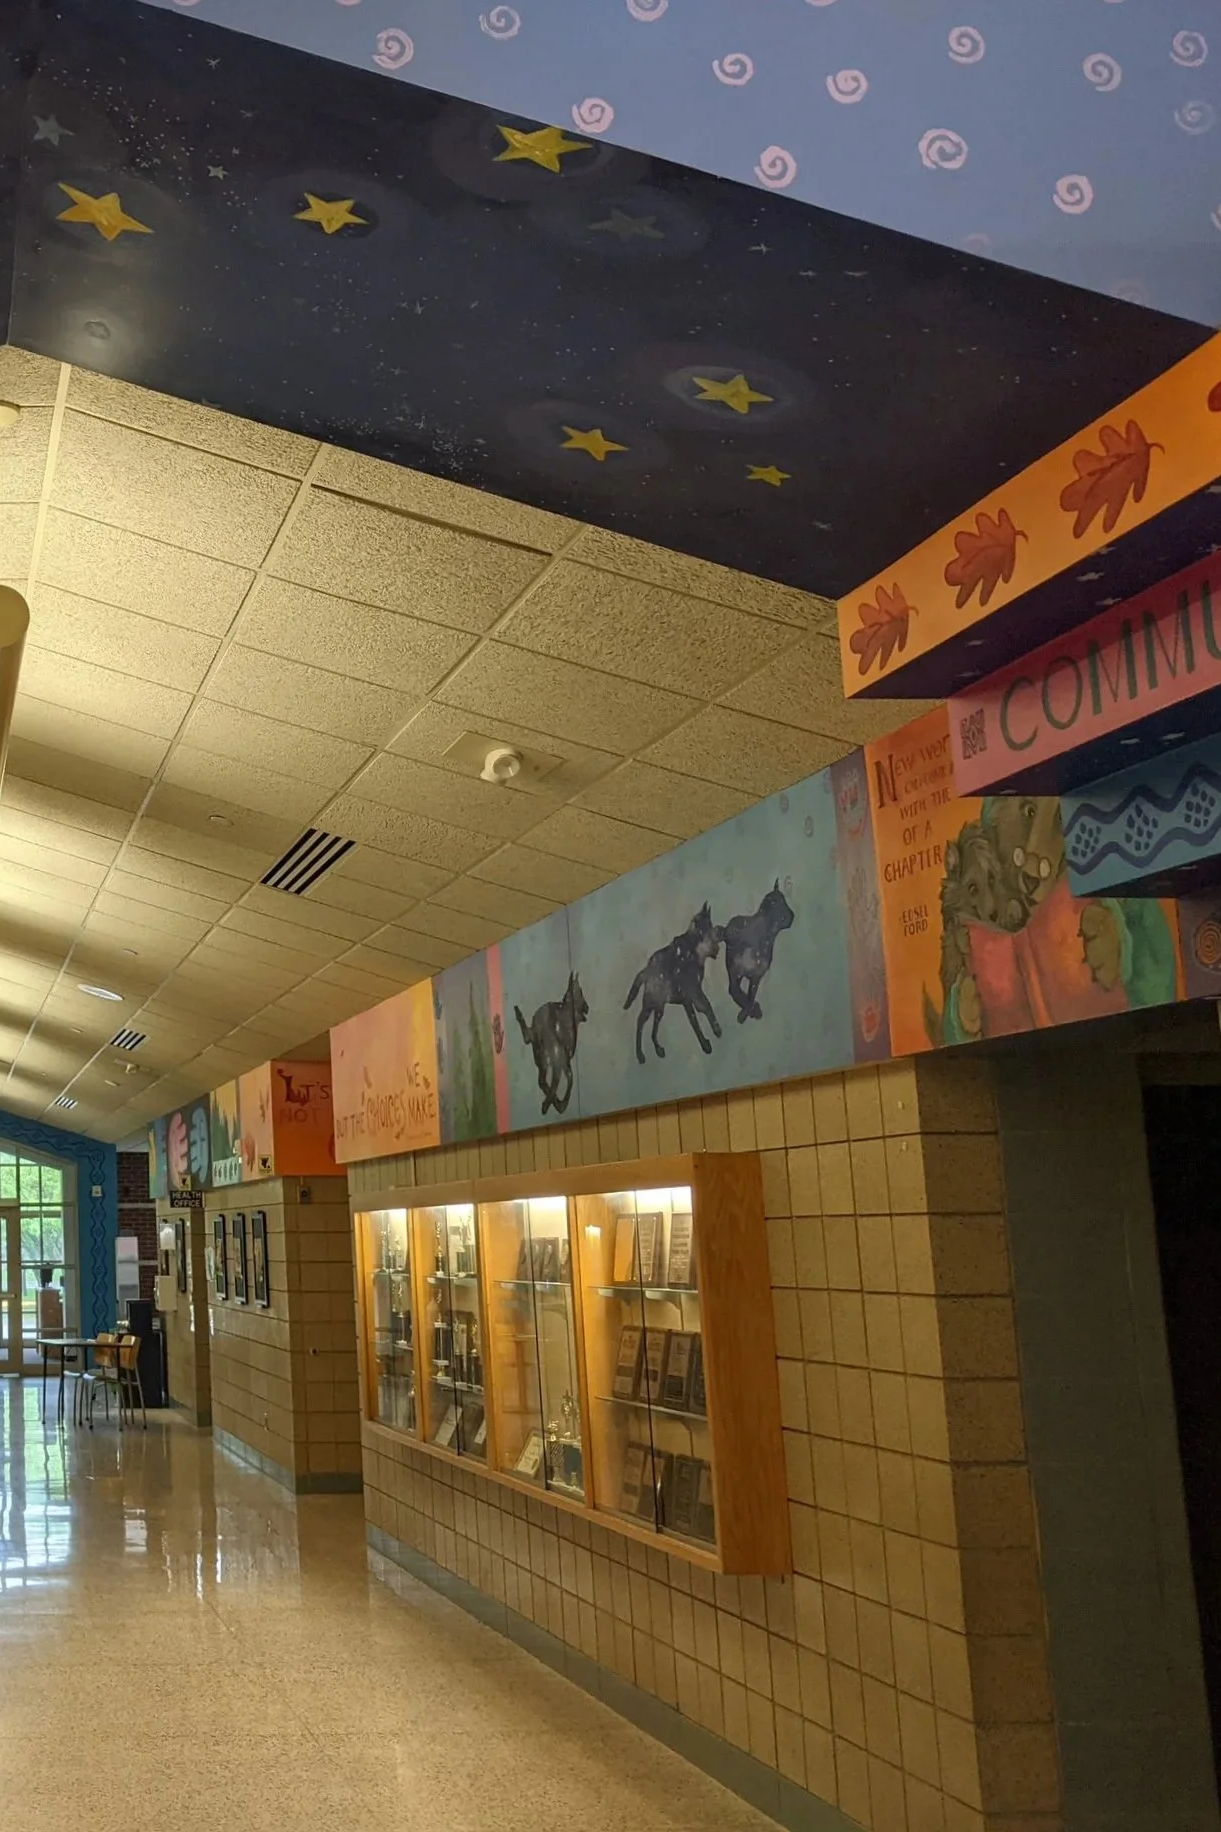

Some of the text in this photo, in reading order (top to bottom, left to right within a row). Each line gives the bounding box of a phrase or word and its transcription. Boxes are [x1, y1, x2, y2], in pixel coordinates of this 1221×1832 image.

[902, 819, 935, 846] OF A
[883, 844, 943, 883] CHAPTER
[406, 1062, 421, 1087] WE
[279, 1107, 321, 1126] NOT
[408, 1093, 437, 1126] MAKE
[172, 1191, 201, 1199] HEALTH
[174, 1199, 200, 1207] OFFICE
